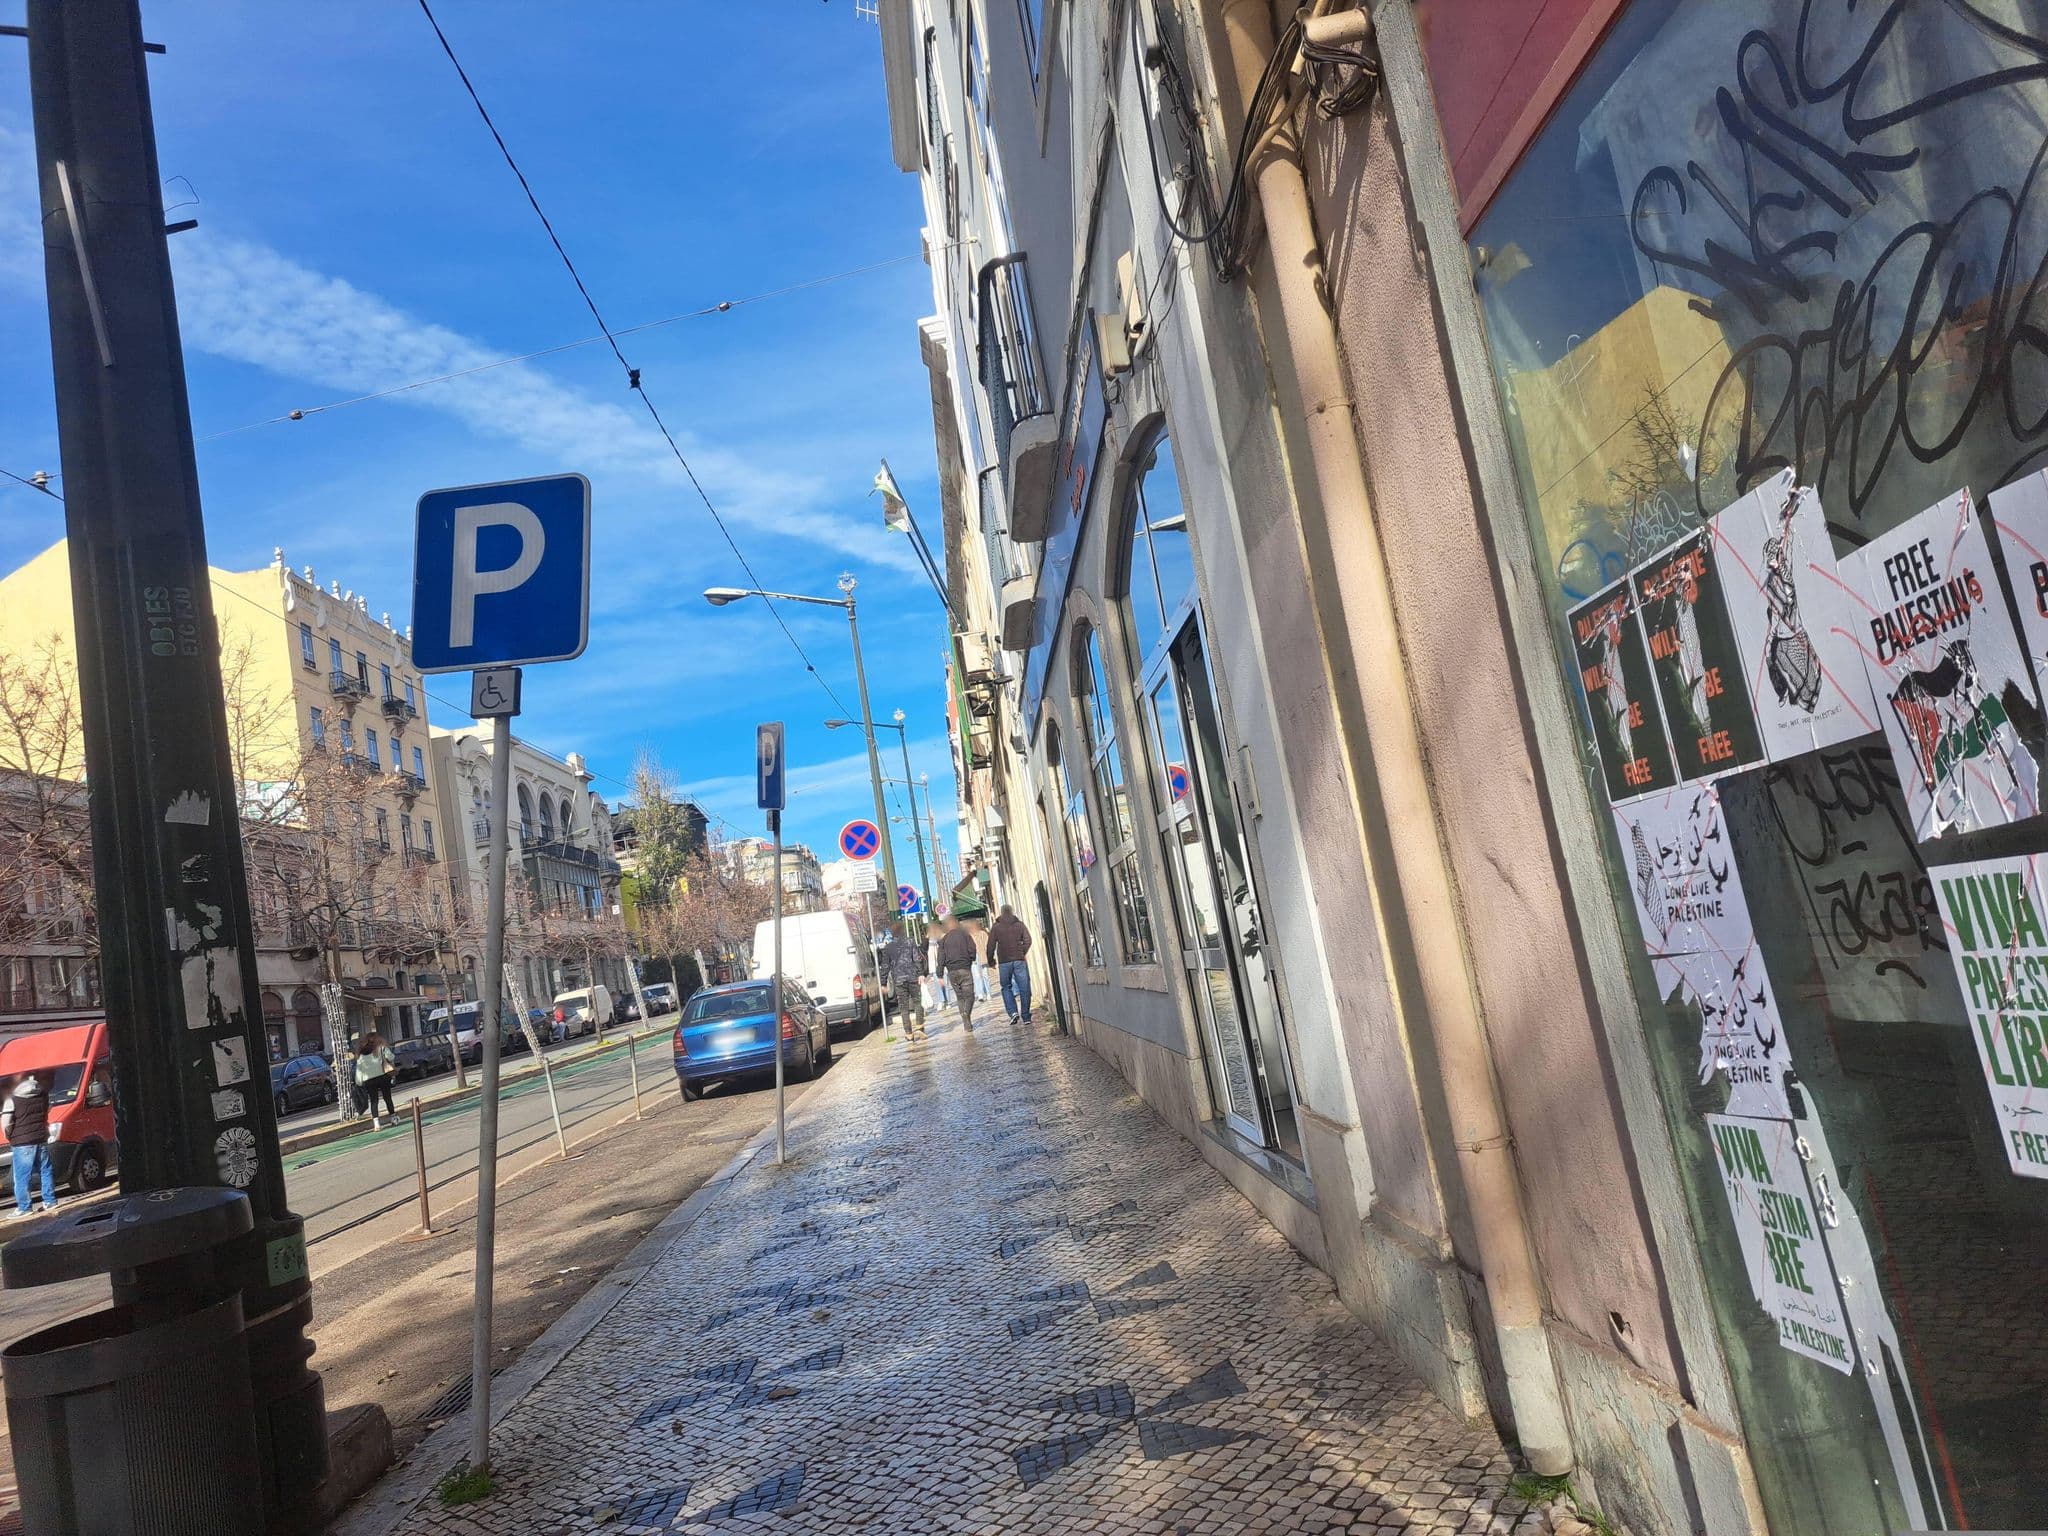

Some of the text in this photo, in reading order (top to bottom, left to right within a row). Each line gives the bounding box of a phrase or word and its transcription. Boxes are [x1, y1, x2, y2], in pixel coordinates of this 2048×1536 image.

[449, 502, 546, 648] P
[1884, 538, 1941, 602] FREE
[1704, 667, 1724, 698] BE
[1627, 701, 1644, 728] BE
[1698, 730, 1734, 765] FREE
[761, 732, 776, 801] P
[1623, 757, 1653, 786] FREE
[1665, 881, 1710, 900] LONG LIVE
[1667, 900, 1724, 922] PALESTINE
[1940, 872, 2048, 951] VIVA
[1713, 1123, 1775, 1185] VIVA
[2010, 1129, 2048, 1165] FRE
[1793, 1324, 1850, 1363] PALESTINE
